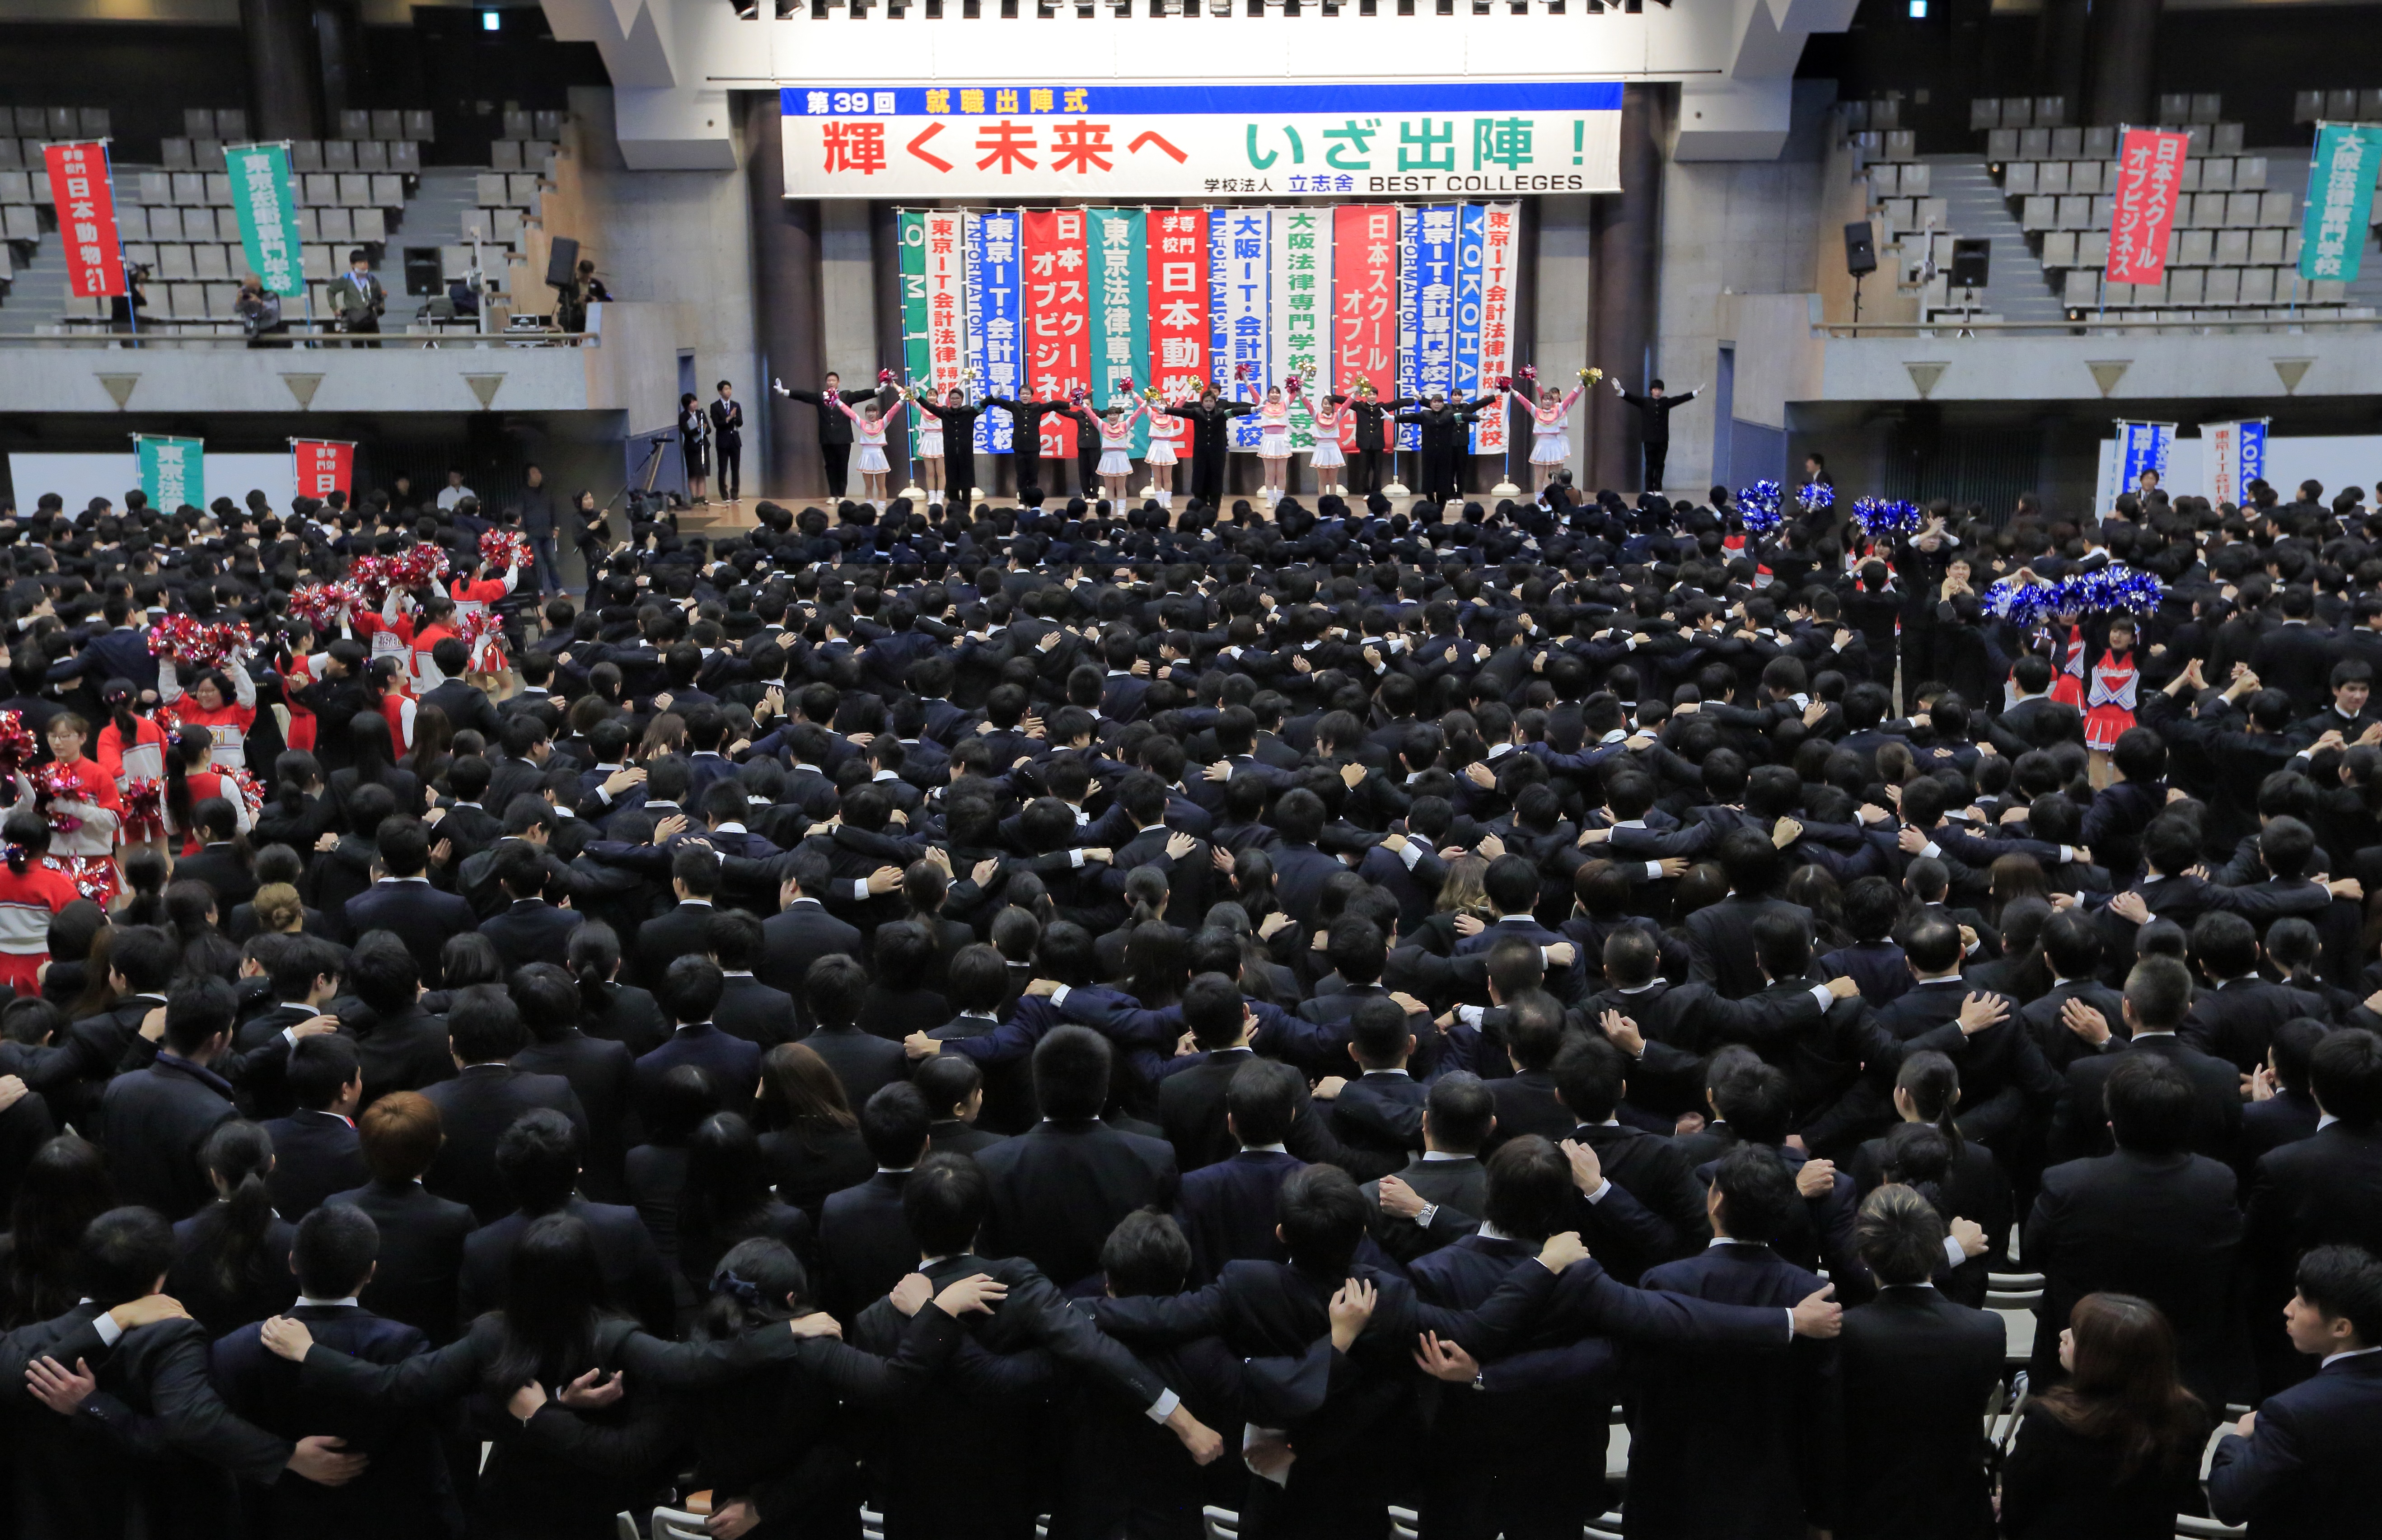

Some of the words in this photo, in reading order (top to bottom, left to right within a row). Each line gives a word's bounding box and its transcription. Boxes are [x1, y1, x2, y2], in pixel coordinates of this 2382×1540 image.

[807, 91, 895, 115] 第39回
[926, 88, 1089, 114] 就職出陣式
[823, 120, 1189, 175] 輝く未来へ
[67, 177, 106, 292] 日本動物21
[1204, 178, 1273, 192] 学校法人
[1288, 174, 1353, 192] 立志舎
[1370, 176, 1437, 192] BEST
[1447, 174, 1583, 191] COLLEGES
[2112, 146, 2152, 276] オブビジネス
[2136, 138, 2179, 269] 日本スクール
[2314, 133, 2366, 276] 大阪法律専門学校
[968, 221, 983, 336] INFORMATION
[1057, 215, 1086, 398] 日本スクール
[1102, 217, 1135, 449] 東京法律専門学
[1212, 217, 1227, 334] INFORMATION
[1288, 213, 1316, 448] 大阪法律専門学校王寺校
[1366, 215, 1389, 370] 日本スクール
[1402, 216, 1418, 332] INFORMATION
[1421, 211, 1455, 410] 東京IT・会計専門学校名
[1459, 216, 1483, 434] YOKOHAM
[971, 346, 989, 449] TECHNOGY
[1399, 345, 1416, 446] TECHNLOGY
